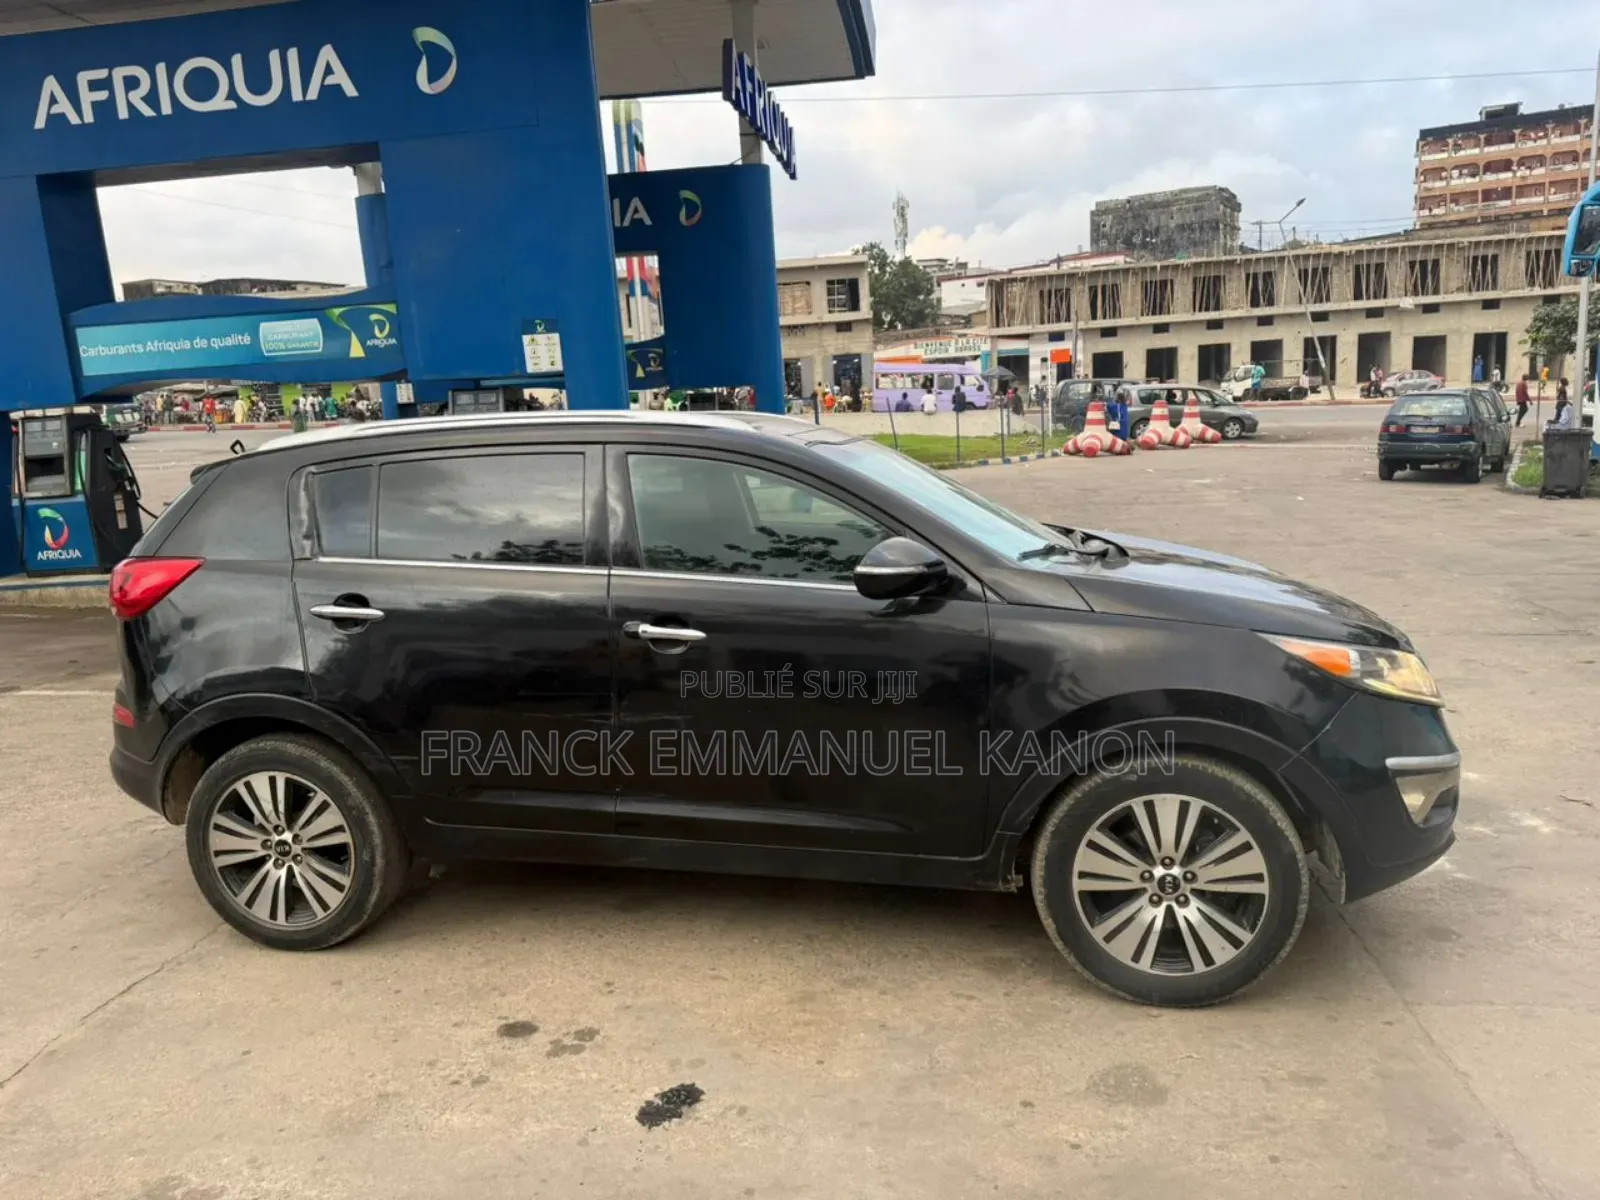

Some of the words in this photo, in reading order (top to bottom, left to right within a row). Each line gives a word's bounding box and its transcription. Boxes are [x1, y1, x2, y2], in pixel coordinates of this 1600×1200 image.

[34, 43, 359, 130] AFRIQUIA
[79, 342, 144, 358] Carburants
[146, 337, 191, 353] Afriquia
[193, 335, 208, 349] de
[210, 332, 251, 347] qualité
[37, 549, 82, 561] AFRIQUIA
